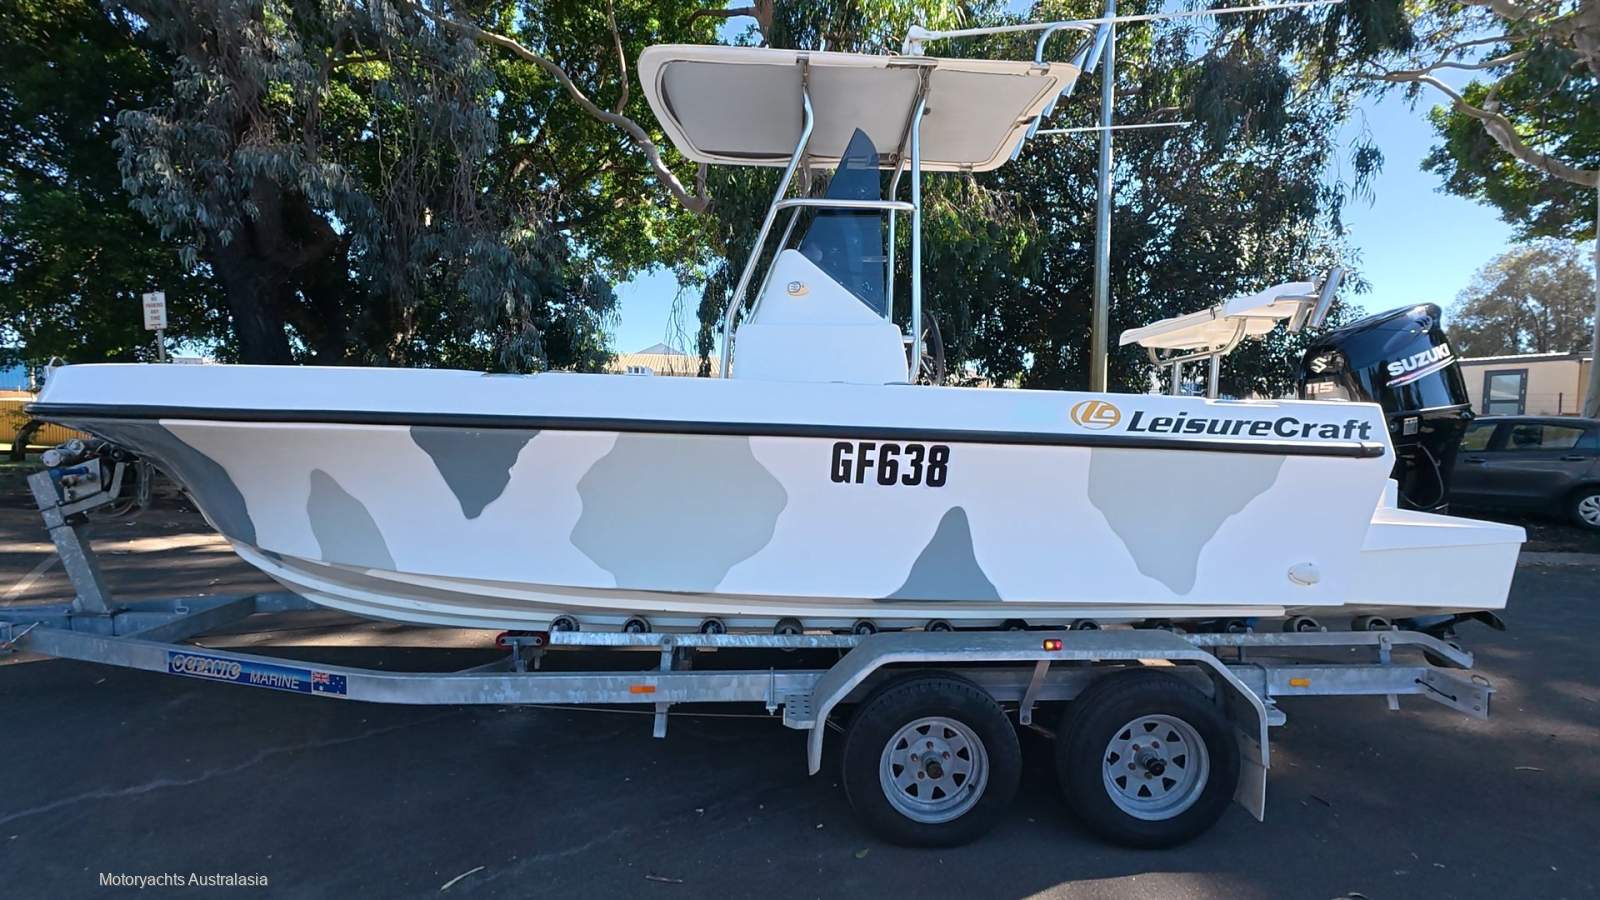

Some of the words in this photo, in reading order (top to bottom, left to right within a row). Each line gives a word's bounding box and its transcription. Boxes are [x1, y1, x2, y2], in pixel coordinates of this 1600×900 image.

[1386, 342, 1451, 377] SUZUKI
[1126, 411, 1372, 441] LeisureCraft
[830, 441, 950, 487] GF638
[171, 653, 242, 680] OCEANIC
[250, 671, 300, 690] MARINE
